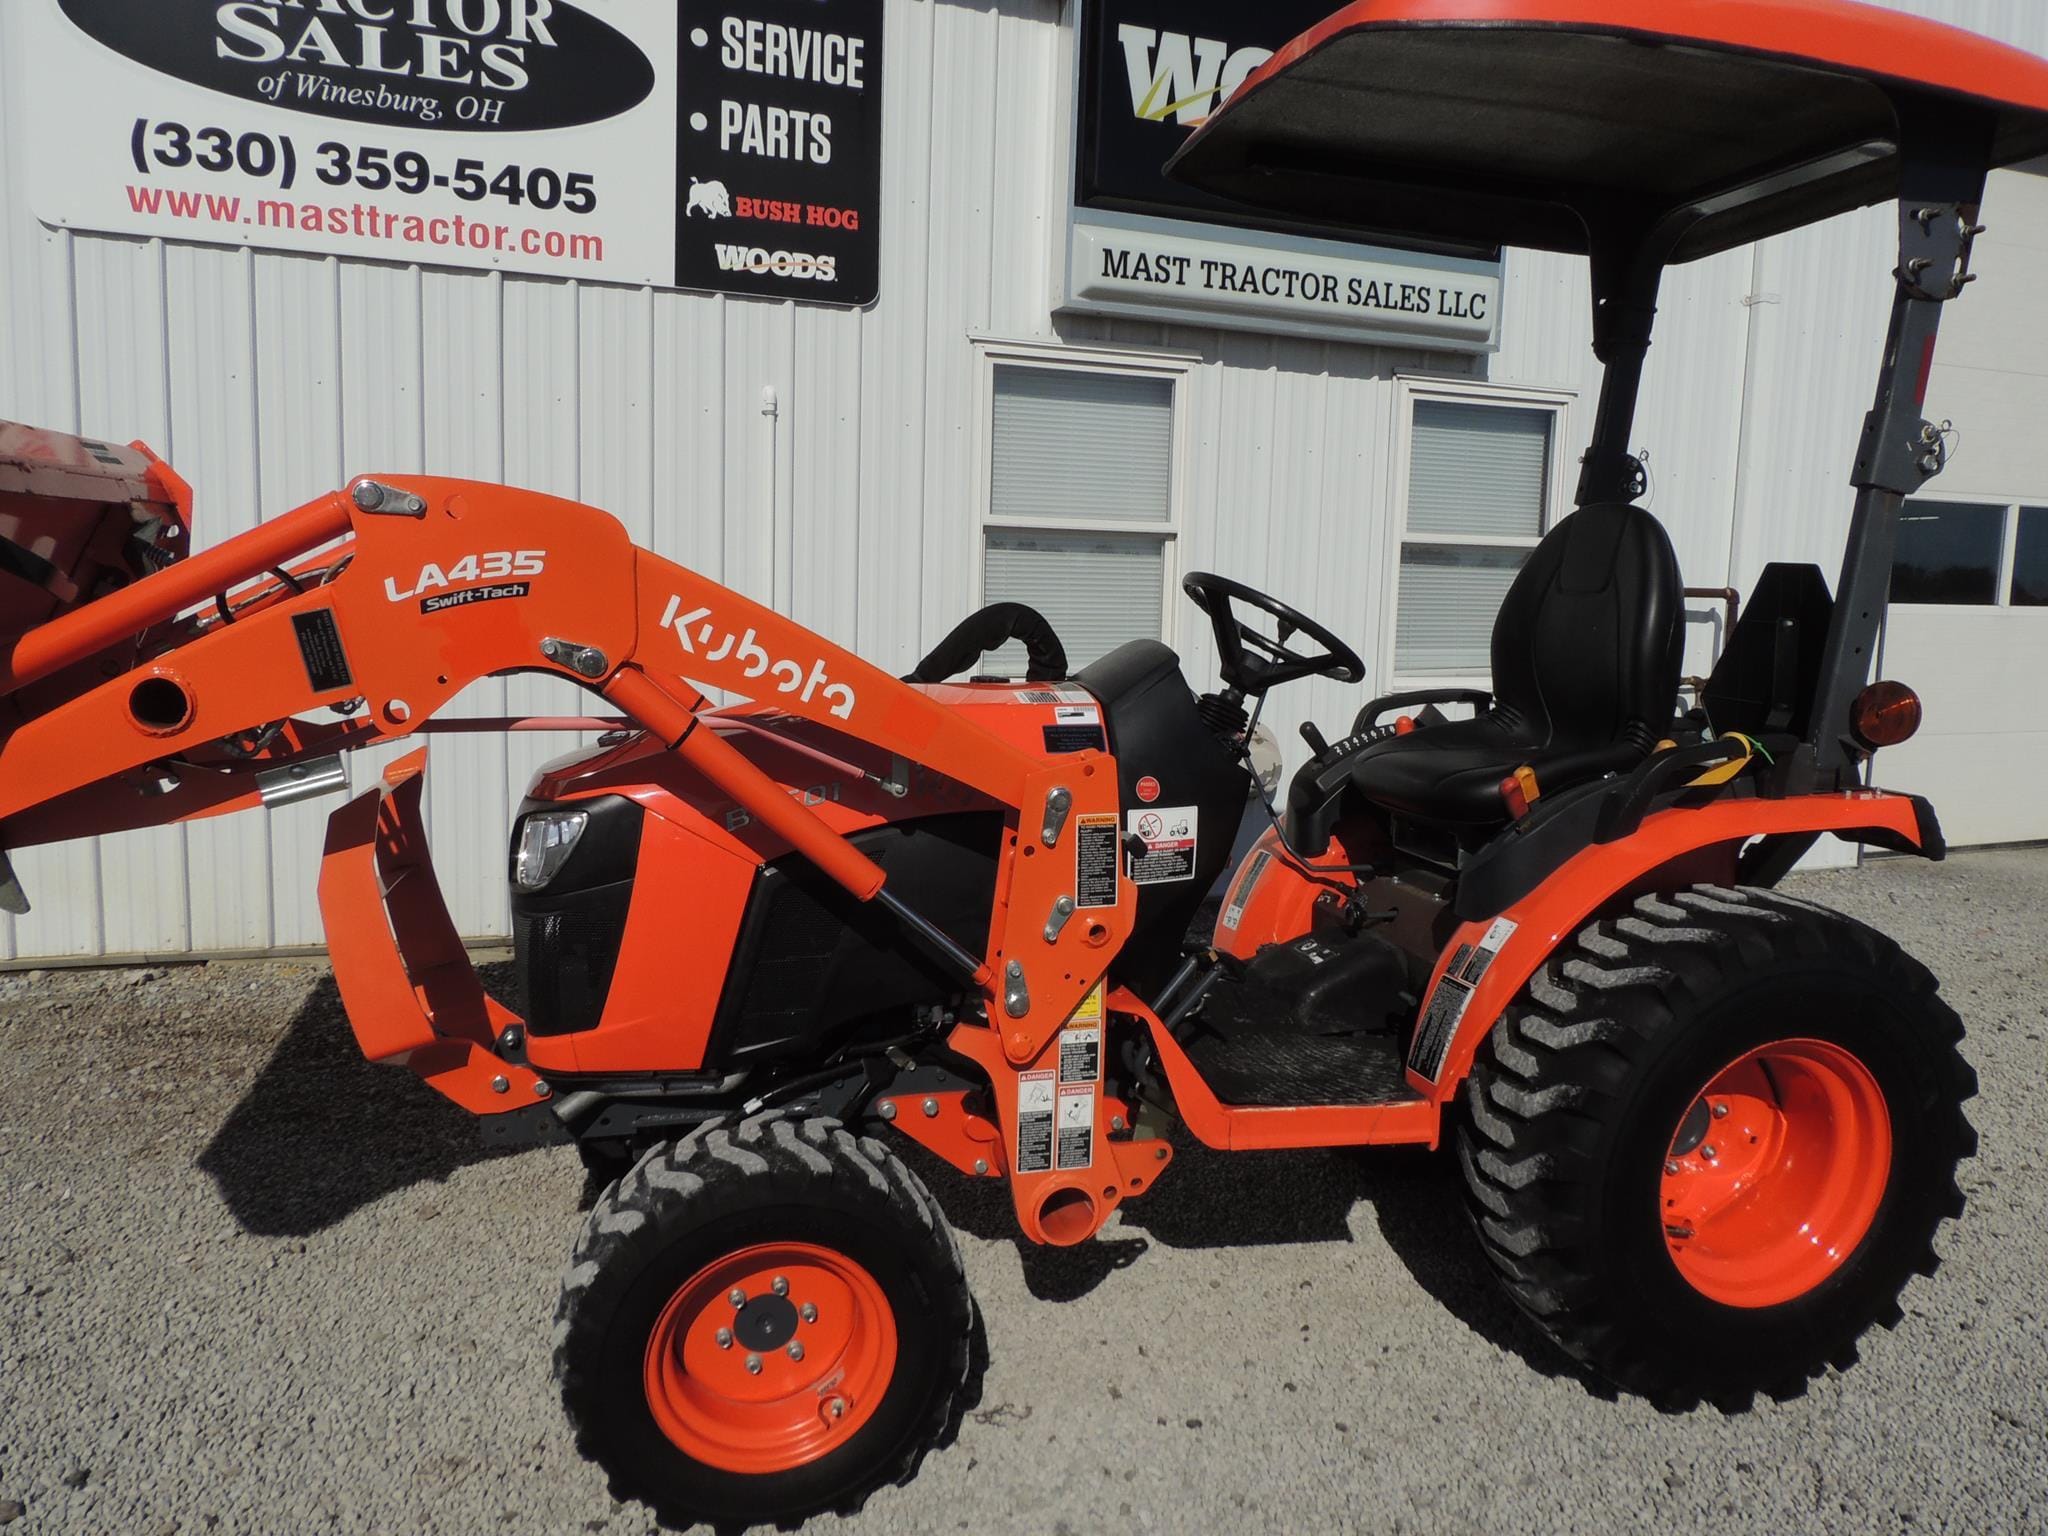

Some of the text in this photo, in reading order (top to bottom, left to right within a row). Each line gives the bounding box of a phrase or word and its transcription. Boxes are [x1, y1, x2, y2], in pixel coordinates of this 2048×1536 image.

[216, 2, 529, 91] SALES
[721, 16, 864, 89] SERVICE
[257, 71, 505, 124] of Winesburg, OH
[720, 99, 832, 165] PARTS
[131, 117, 598, 215] (330) 359-5405
[126, 185, 604, 261] www.masttractor.com
[736, 196, 859, 231] BUSH HOG
[715, 244, 836, 282] WOODS
[1101, 248, 1487, 320] MAST TRACTOR SALES LLC
[384, 550, 546, 602] LA435
[426, 584, 525, 612] Swift-Tach
[659, 594, 856, 720] Kubota
[1155, 841, 1179, 849] DANGER
[1026, 1072, 1053, 1080] DANGER
[1066, 1087, 1092, 1095] DANGER
